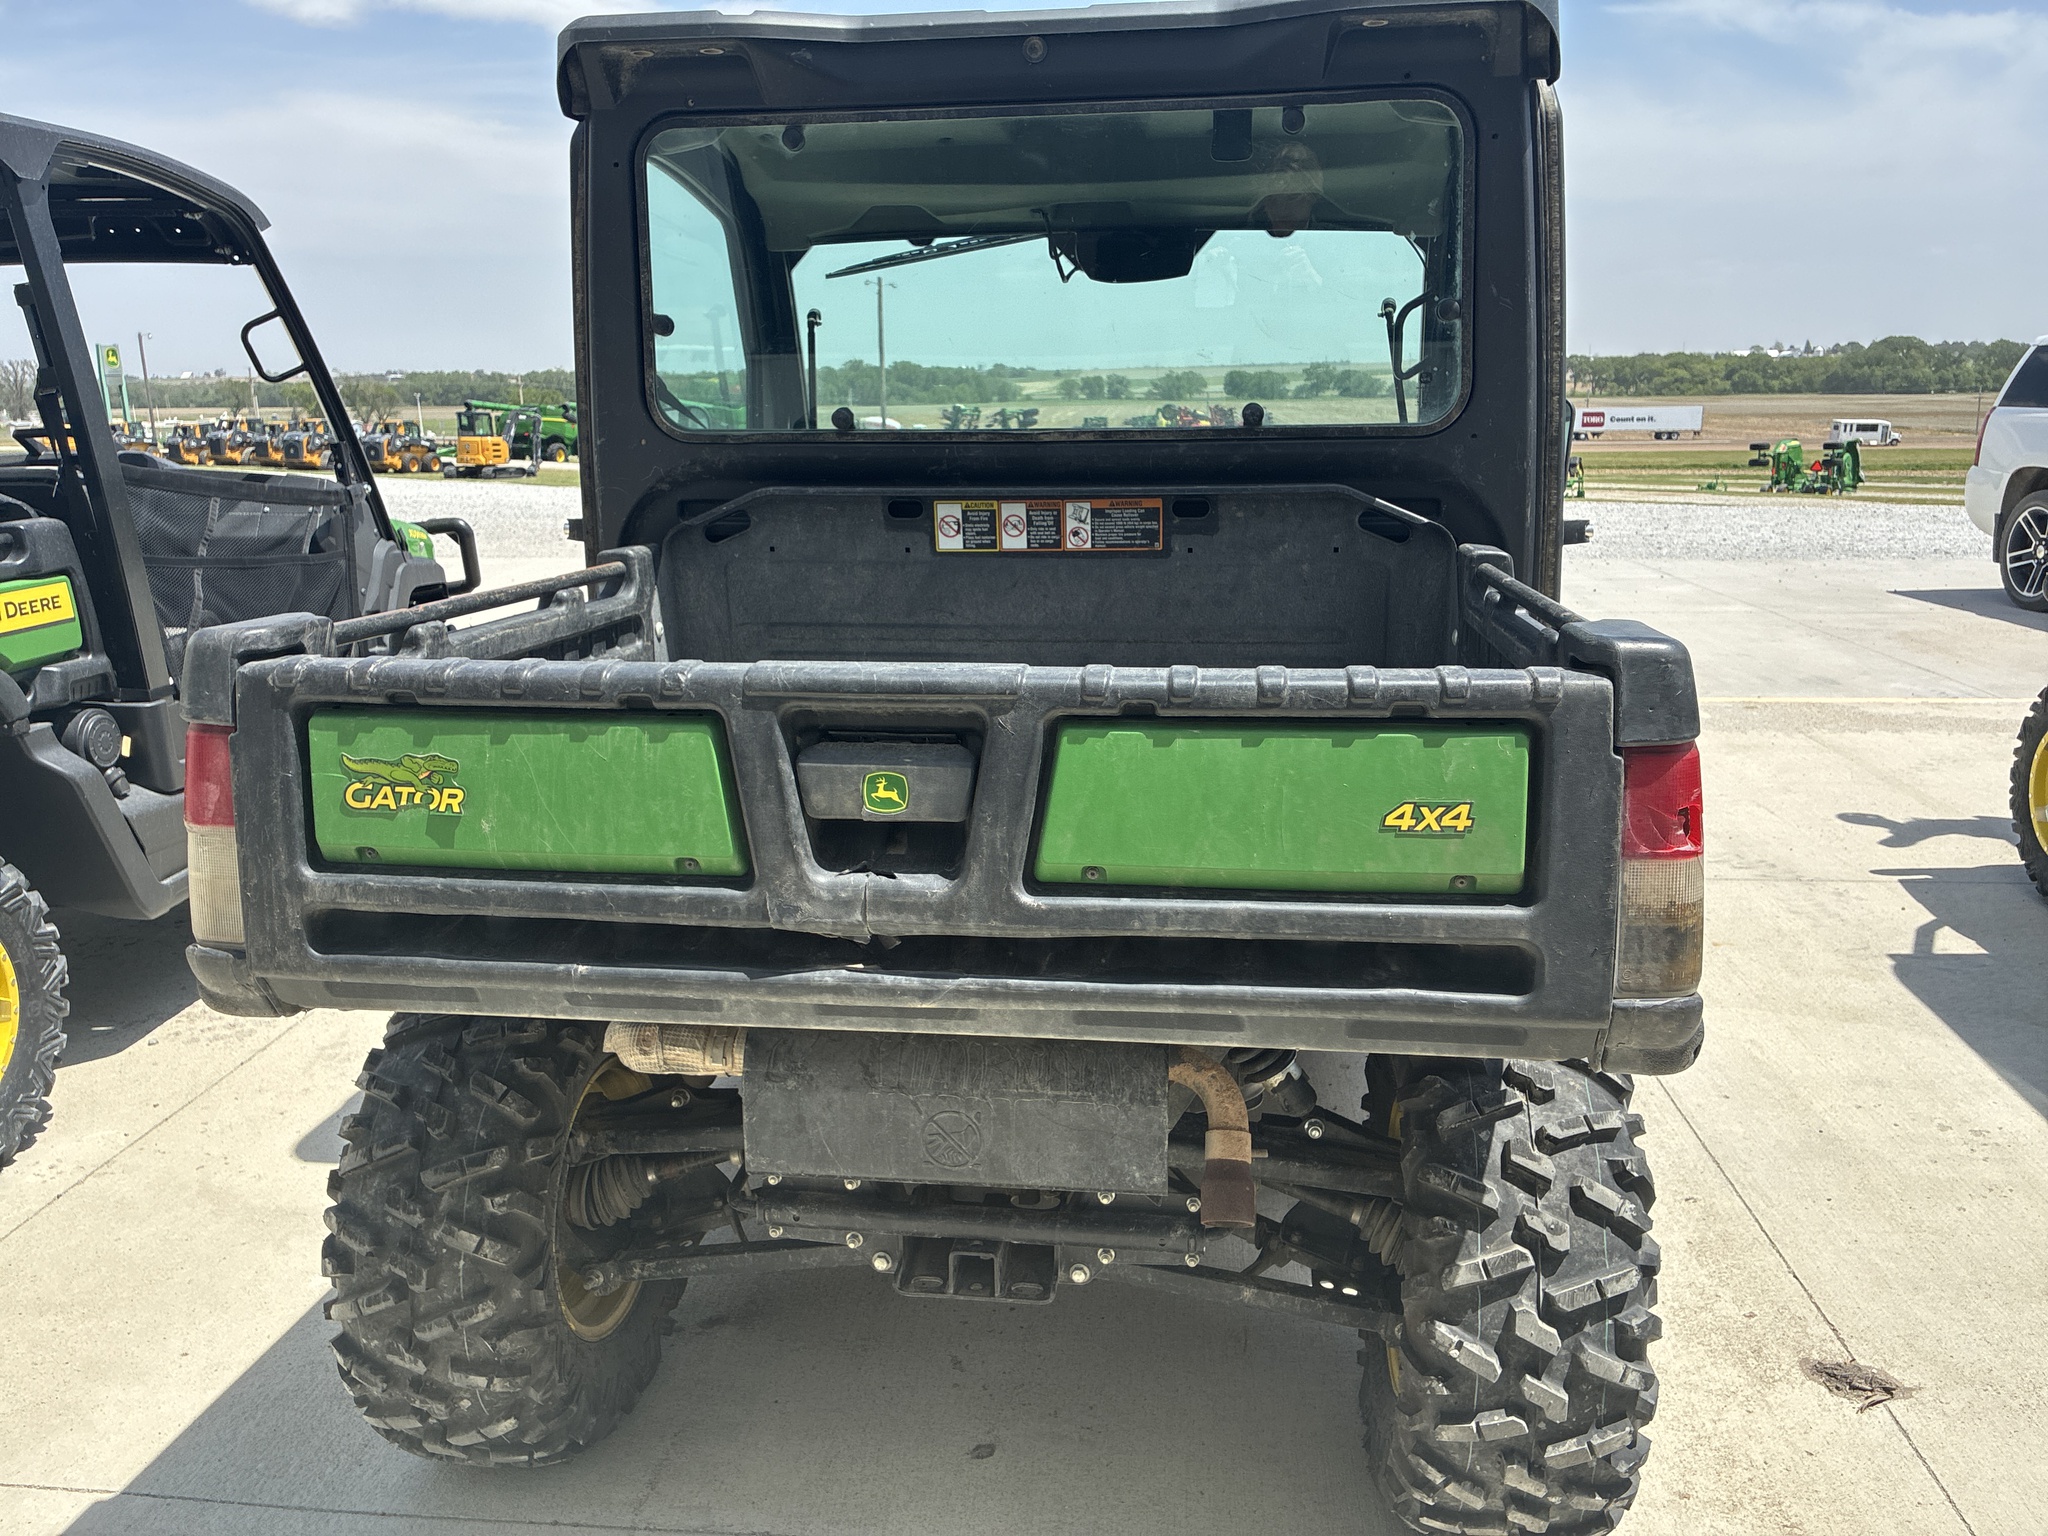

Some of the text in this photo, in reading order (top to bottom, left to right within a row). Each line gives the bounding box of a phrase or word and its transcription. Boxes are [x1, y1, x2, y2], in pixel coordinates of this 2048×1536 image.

[1583, 415, 1603, 424] TORO
[1610, 415, 1635, 423] Count
[3, 594, 62, 619] DEERE
[345, 781, 465, 813] GATOR
